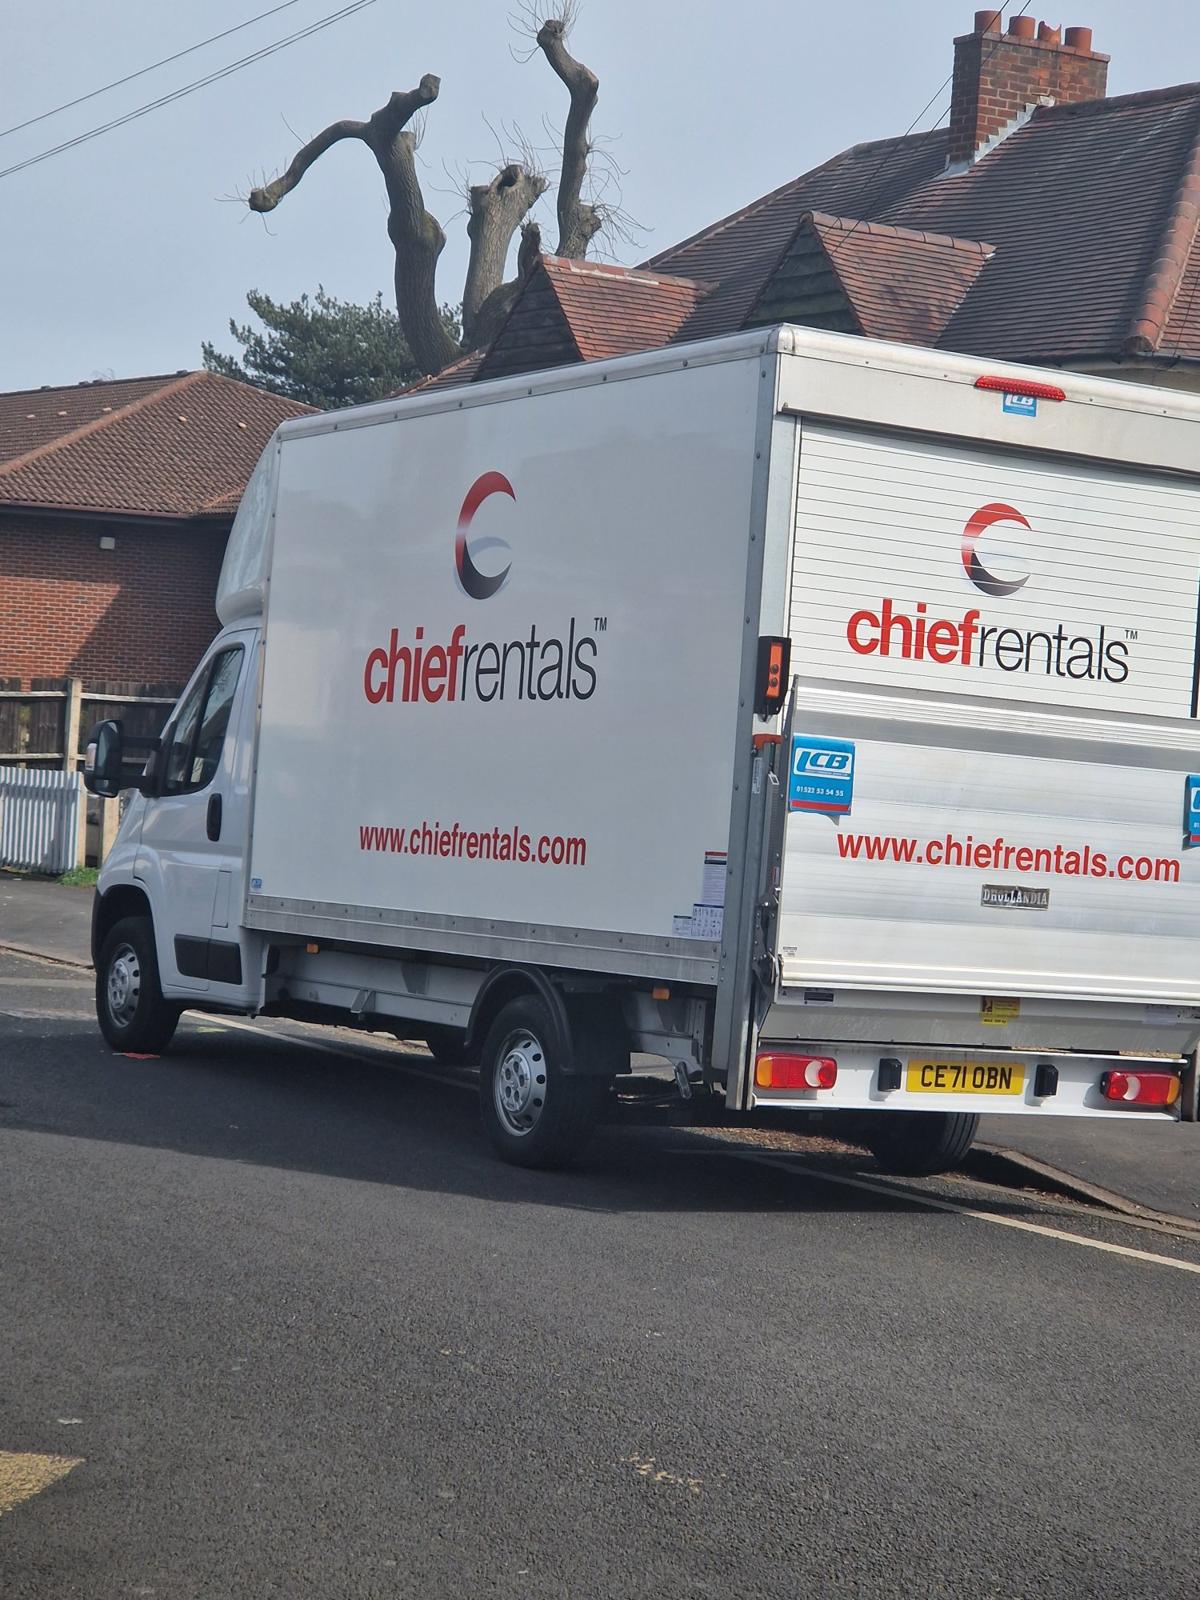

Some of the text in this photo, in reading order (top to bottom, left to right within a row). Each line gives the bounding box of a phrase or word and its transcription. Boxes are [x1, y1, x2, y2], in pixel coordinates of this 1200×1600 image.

[363, 616, 598, 704] chiefrentals
[847, 598, 1130, 684] chiefrentals
[359, 821, 587, 866] www.chiefrentals.com
[837, 833, 1181, 883] www.chiefrentals.com
[920, 1065, 1013, 1090] CE71 OBN
